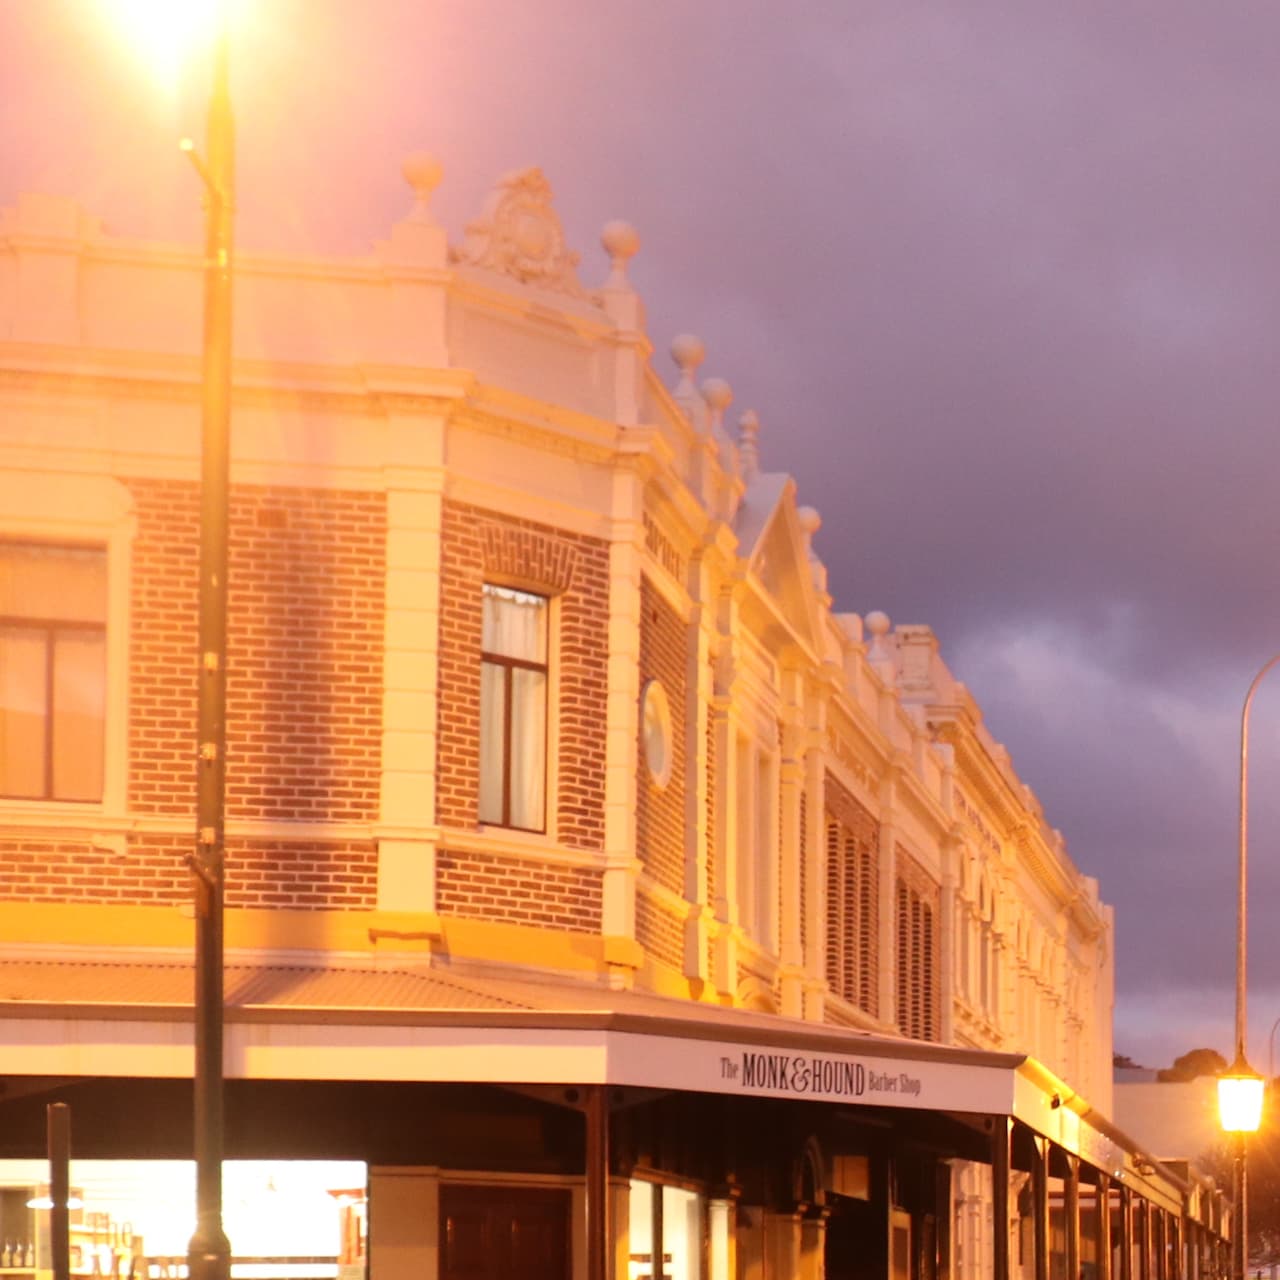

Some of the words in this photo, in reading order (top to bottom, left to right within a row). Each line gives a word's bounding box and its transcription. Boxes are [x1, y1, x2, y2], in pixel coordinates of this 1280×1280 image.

[720, 1057, 739, 1079] The
[868, 1070, 898, 1092] Barber
[899, 1073, 921, 1097] Shop
